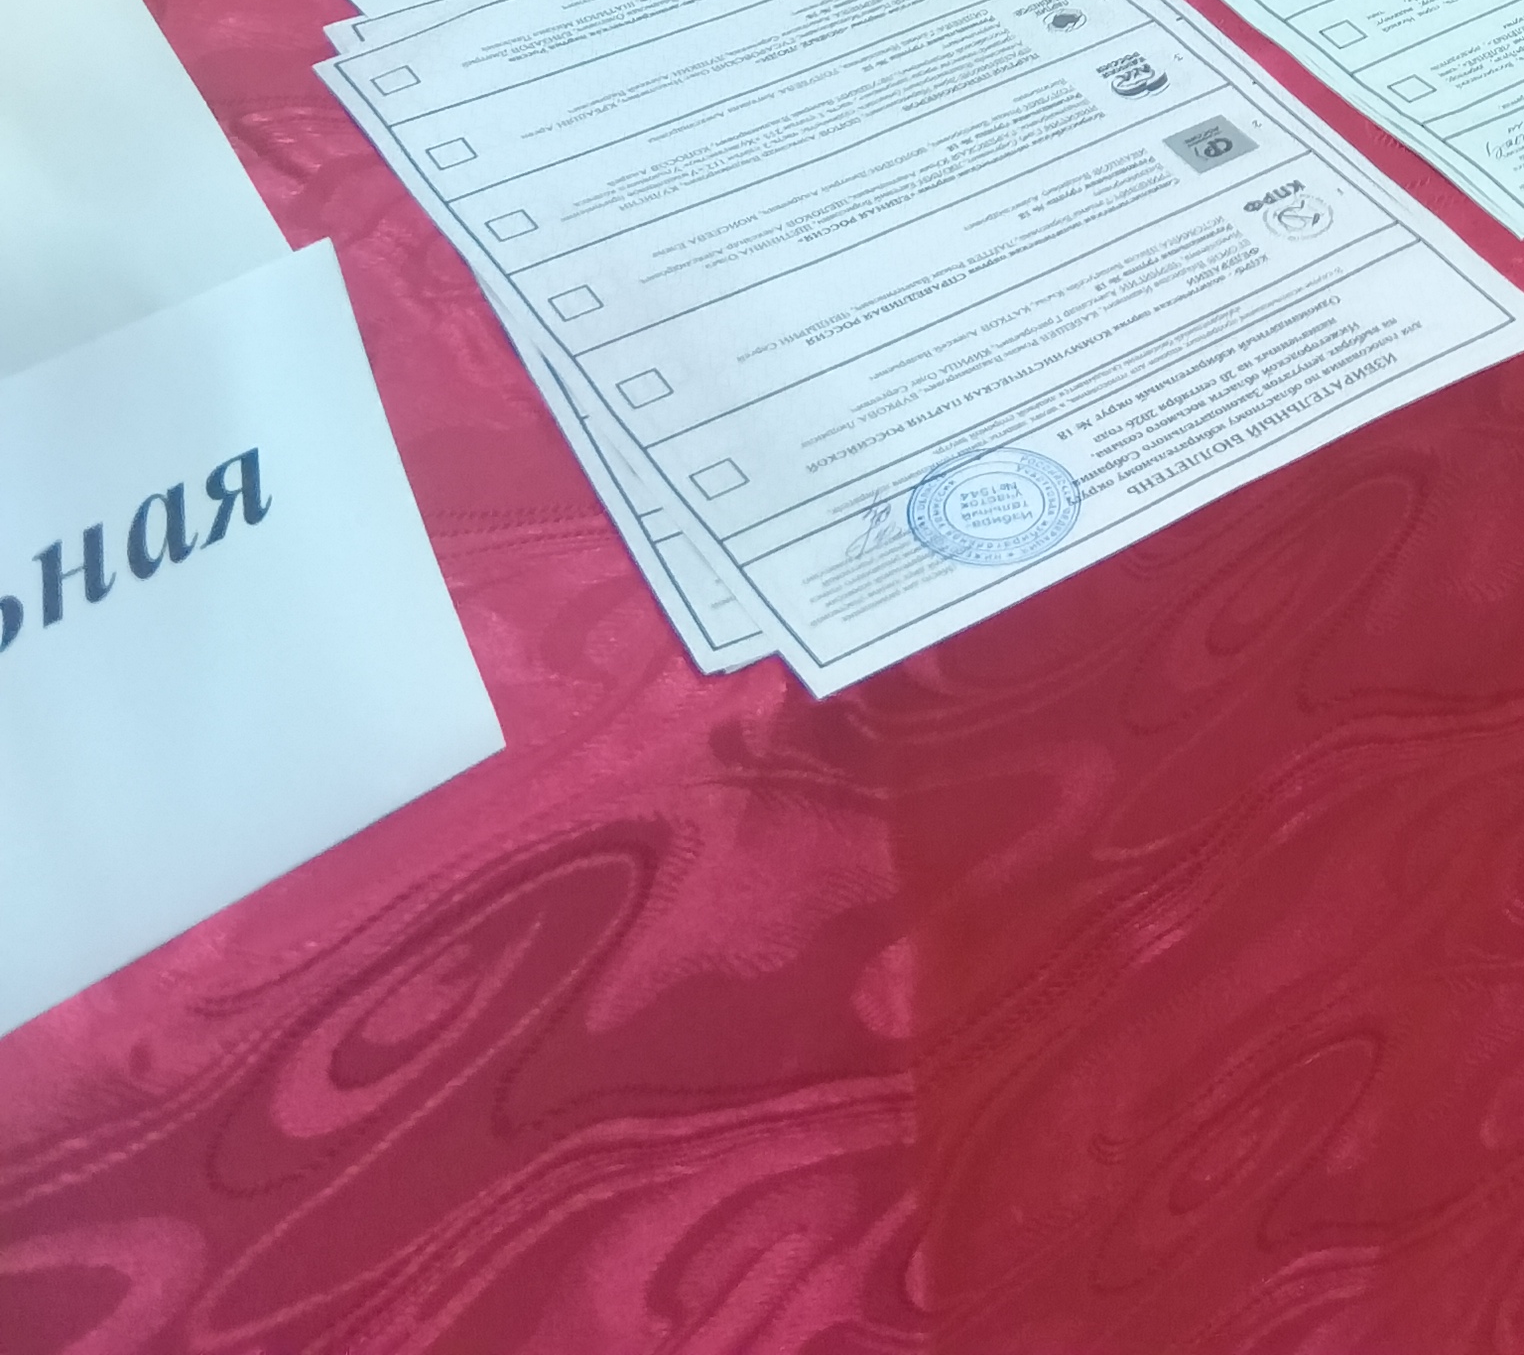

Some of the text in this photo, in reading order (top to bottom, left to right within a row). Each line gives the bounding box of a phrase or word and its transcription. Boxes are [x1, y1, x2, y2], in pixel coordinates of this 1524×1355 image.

[1237, 178, 1308, 215] КПРФ
[793, 215, 858, 245] РОССИЯ»
[802, 270, 968, 346] СПРАВЕДЛИВАЯ РОССИЯ
[960, 328, 1114, 402] КОММУНИСТИЧЕСКАЯ
[1131, 345, 1239, 402] избирательный
[903, 396, 963, 428] ПАРТИЯ
[1090, 395, 1136, 423] округ
[1154, 376, 1220, 412] сентября
[1053, 425, 1075, 441] 18
[1122, 351, 1399, 499] ИЗБИРАТЕЛЬНЫЙ БЮЛЛЕТЕНЬ
[1137, 386, 1262, 453] Законодательного
[803, 422, 906, 474] РОССИЙСКОЙ
